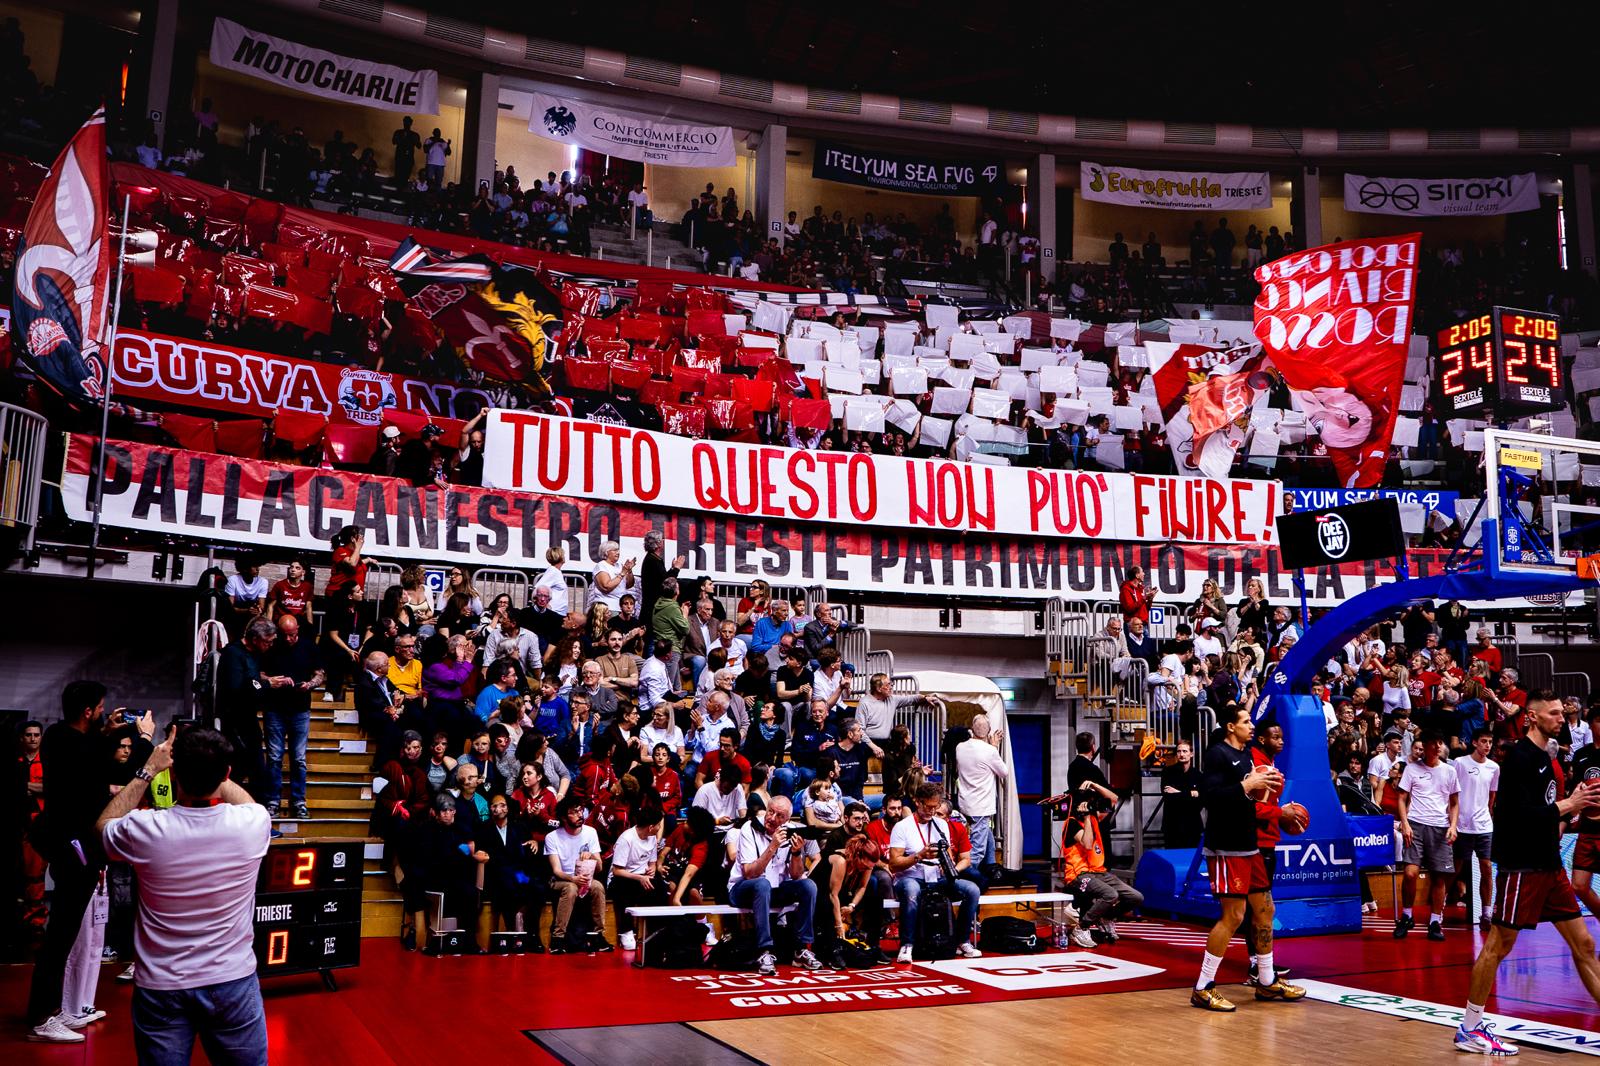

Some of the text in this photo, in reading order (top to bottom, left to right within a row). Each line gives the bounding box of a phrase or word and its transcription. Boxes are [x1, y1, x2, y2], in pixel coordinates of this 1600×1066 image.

[593, 117, 717, 145] CONFCOMMERCIO
[644, 151, 669, 160] TRIESTE
[825, 149, 974, 184] ITELYUM SEA FVG
[1107, 172, 1263, 199] Eurofrutta TRIESTE
[1443, 202, 1500, 213] visual team
[1450, 315, 1491, 346] 2:05
[112, 333, 333, 417] CURVA
[1442, 341, 1493, 395] 24
[1504, 340, 1558, 387] 24
[501, 412, 661, 502] TUTTO
[692, 441, 878, 522] QUESTO
[906, 459, 996, 532] NON
[86, 440, 621, 566] PALLACANESTRO
[643, 511, 849, 582] TRIESTE
[871, 530, 1186, 595] PATRIMONIO
[1323, 520, 1343, 537] DEE
[1326, 535, 1344, 551] JAY
[427, 573, 441, 590] C
[1152, 610, 1162, 623] D
[157, 784, 169, 796] 58
[1353, 834, 1389, 847] molten
[1274, 843, 1353, 867] TAL
[293, 851, 314, 885] 2
[1322, 868, 1354, 881] pipeline
[256, 904, 292, 922] TRIESTE
[268, 931, 289, 965] 0
[696, 974, 852, 990] JUMP
[729, 984, 972, 1009] COURTSIDE
